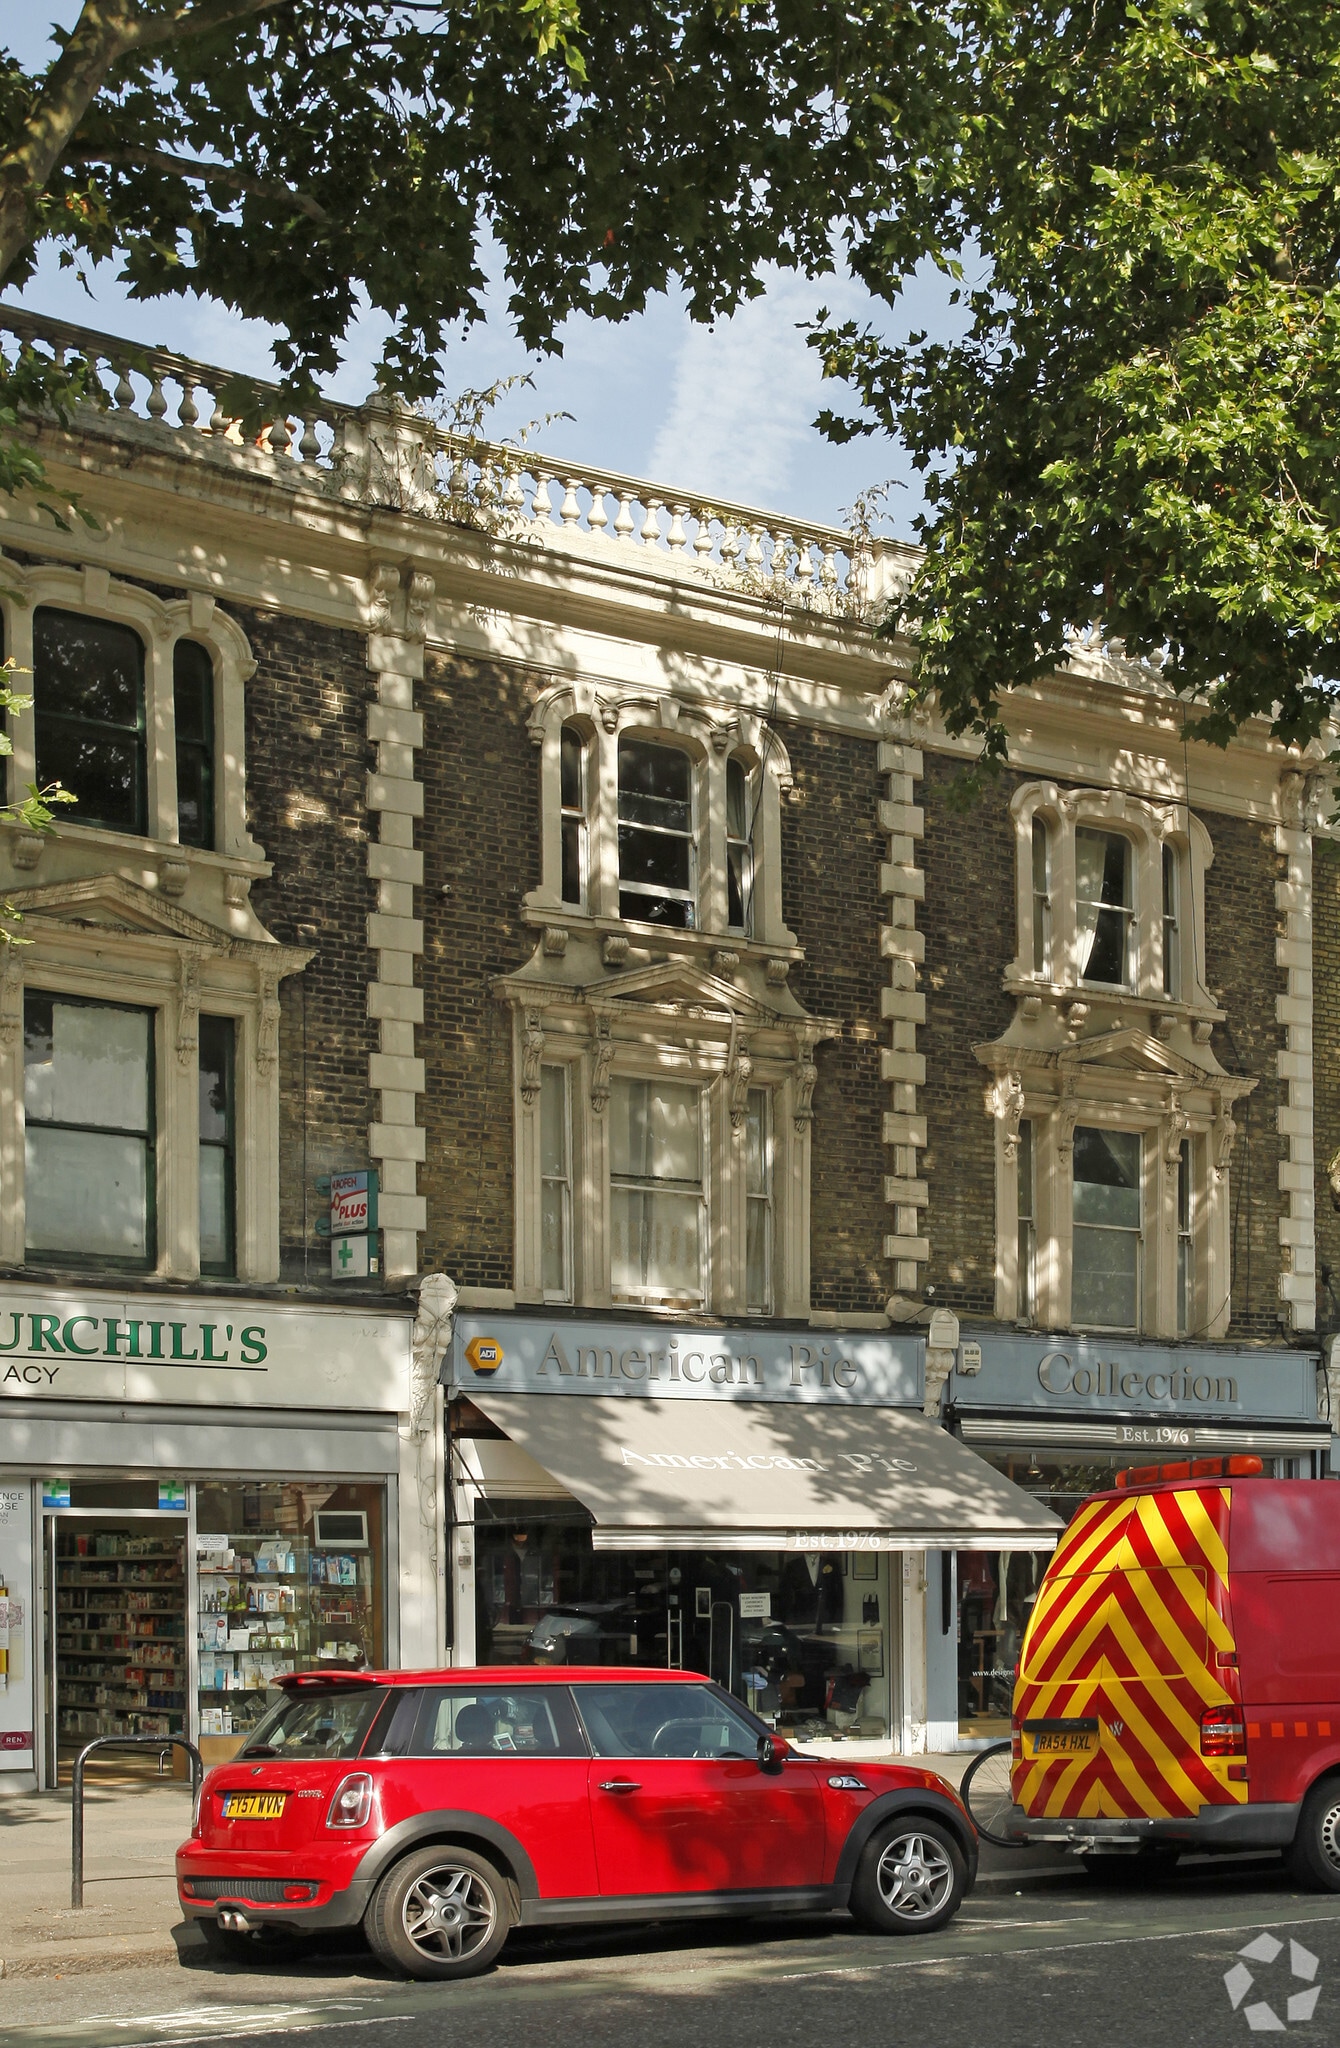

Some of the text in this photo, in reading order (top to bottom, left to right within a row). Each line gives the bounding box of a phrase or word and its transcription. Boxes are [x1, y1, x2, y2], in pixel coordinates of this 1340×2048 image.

[339, 1203, 367, 1219] PLUS
[479, 1347, 497, 1360] ADT
[536, 1332, 858, 1388] American Pie
[3, 1365, 60, 1384] ACY
[1037, 1352, 1239, 1402] Collection
[1121, 1427, 1189, 1444] Est.1976
[620, 1446, 918, 1472] American Pie
[0, 1492, 24, 1501] NCE
[794, 1530, 881, 1549] Est.1976
[1039, 1734, 1091, 1750] RA54 HXL
[228, 1795, 256, 1814] FY57
